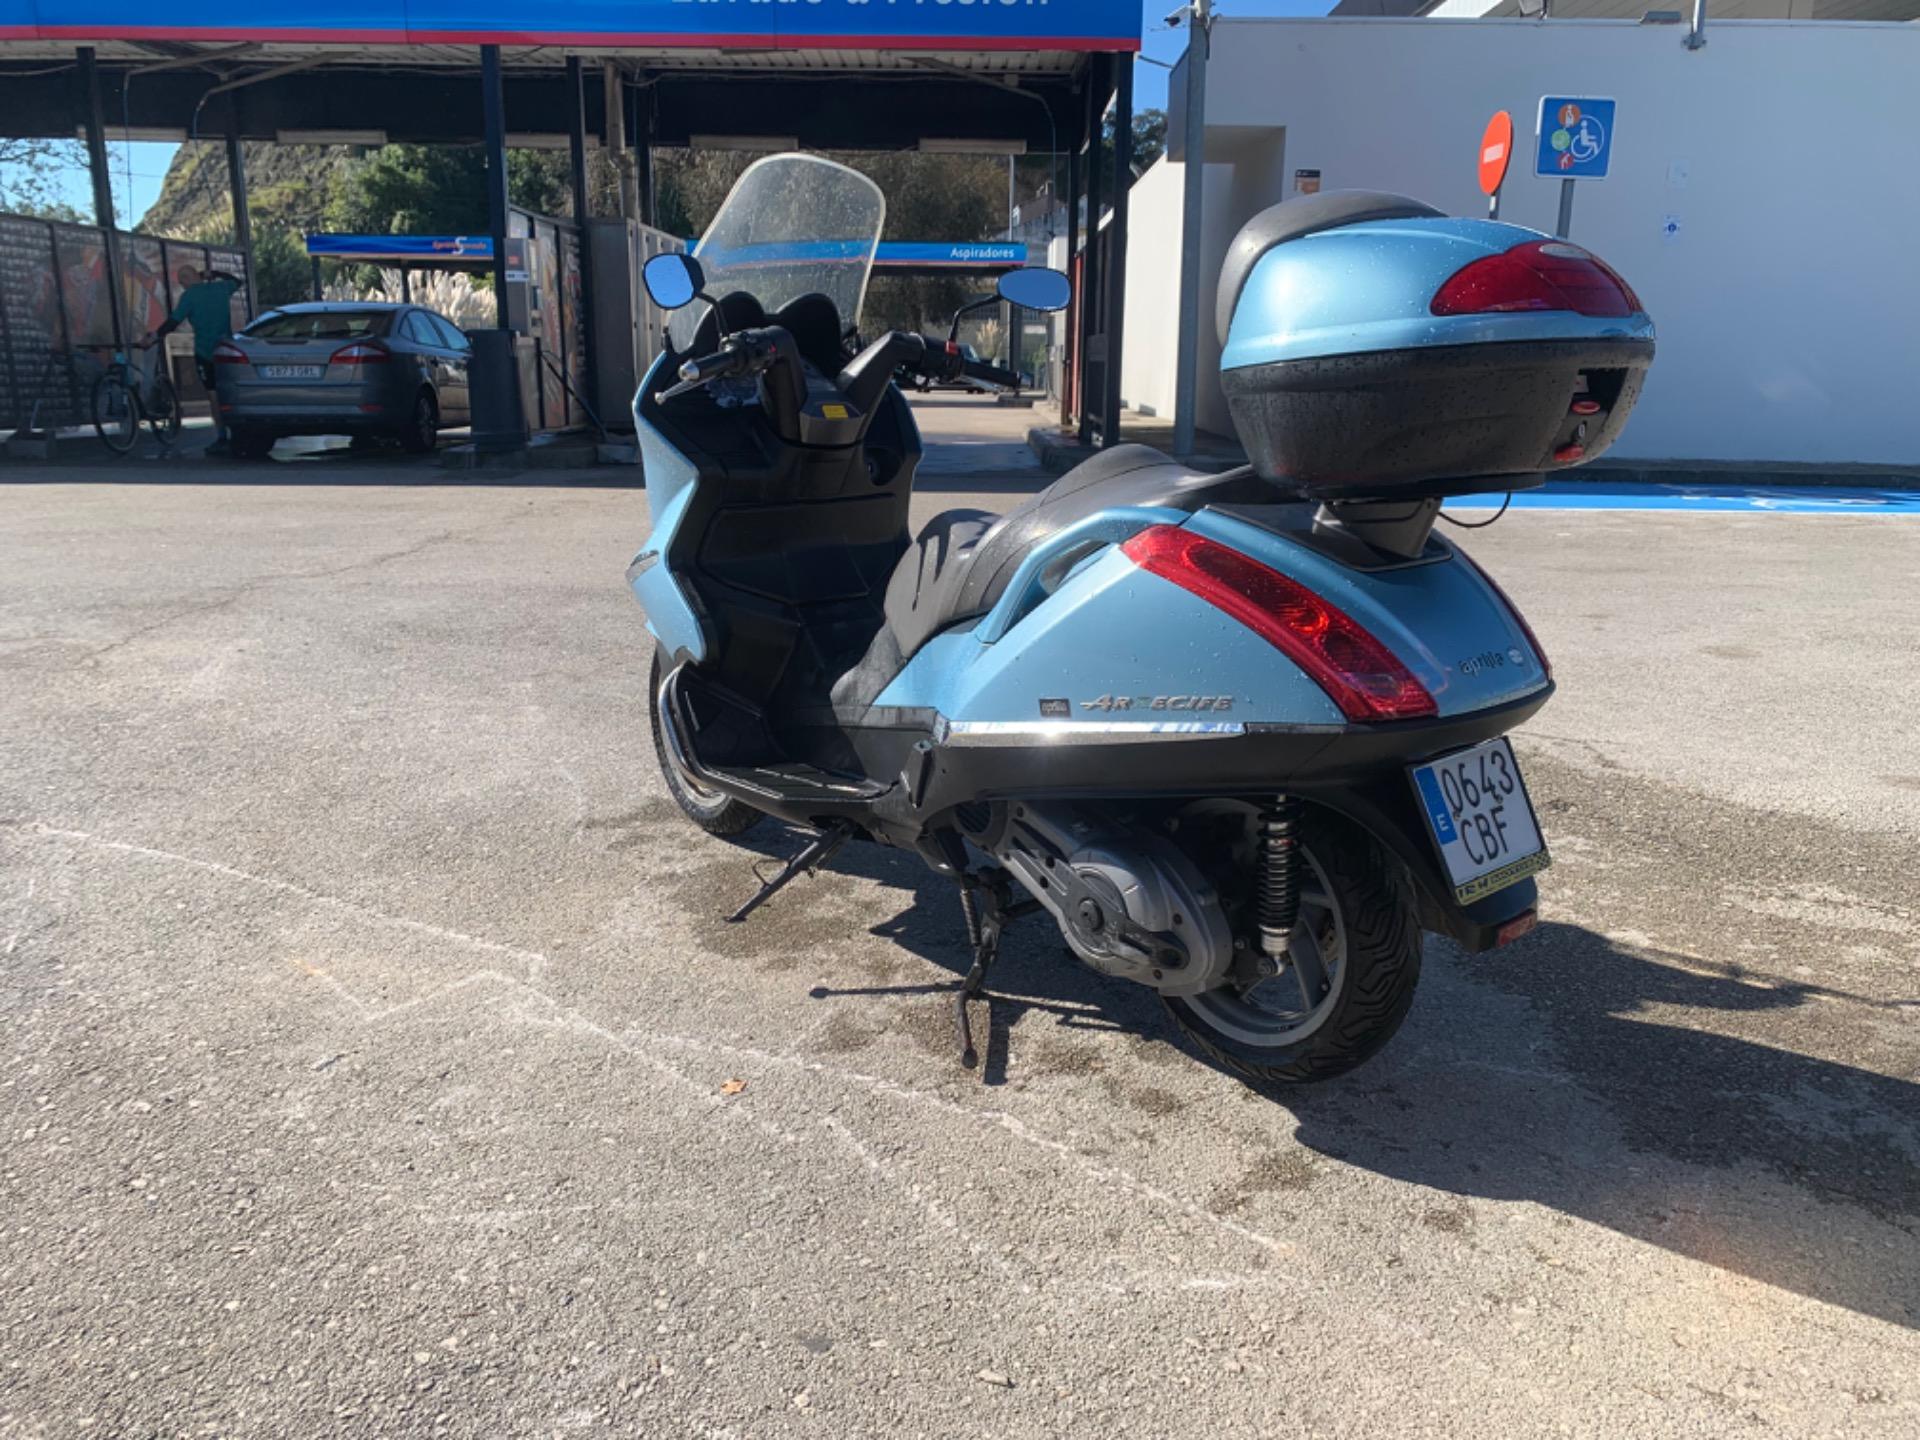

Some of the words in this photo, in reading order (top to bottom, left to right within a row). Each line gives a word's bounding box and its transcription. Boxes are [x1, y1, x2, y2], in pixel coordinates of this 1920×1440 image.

[950, 247, 1015, 261] Aspiradores
[1441, 750, 1514, 814] 0643
[1436, 813, 1449, 831] E
[1461, 805, 1509, 865] CBF
